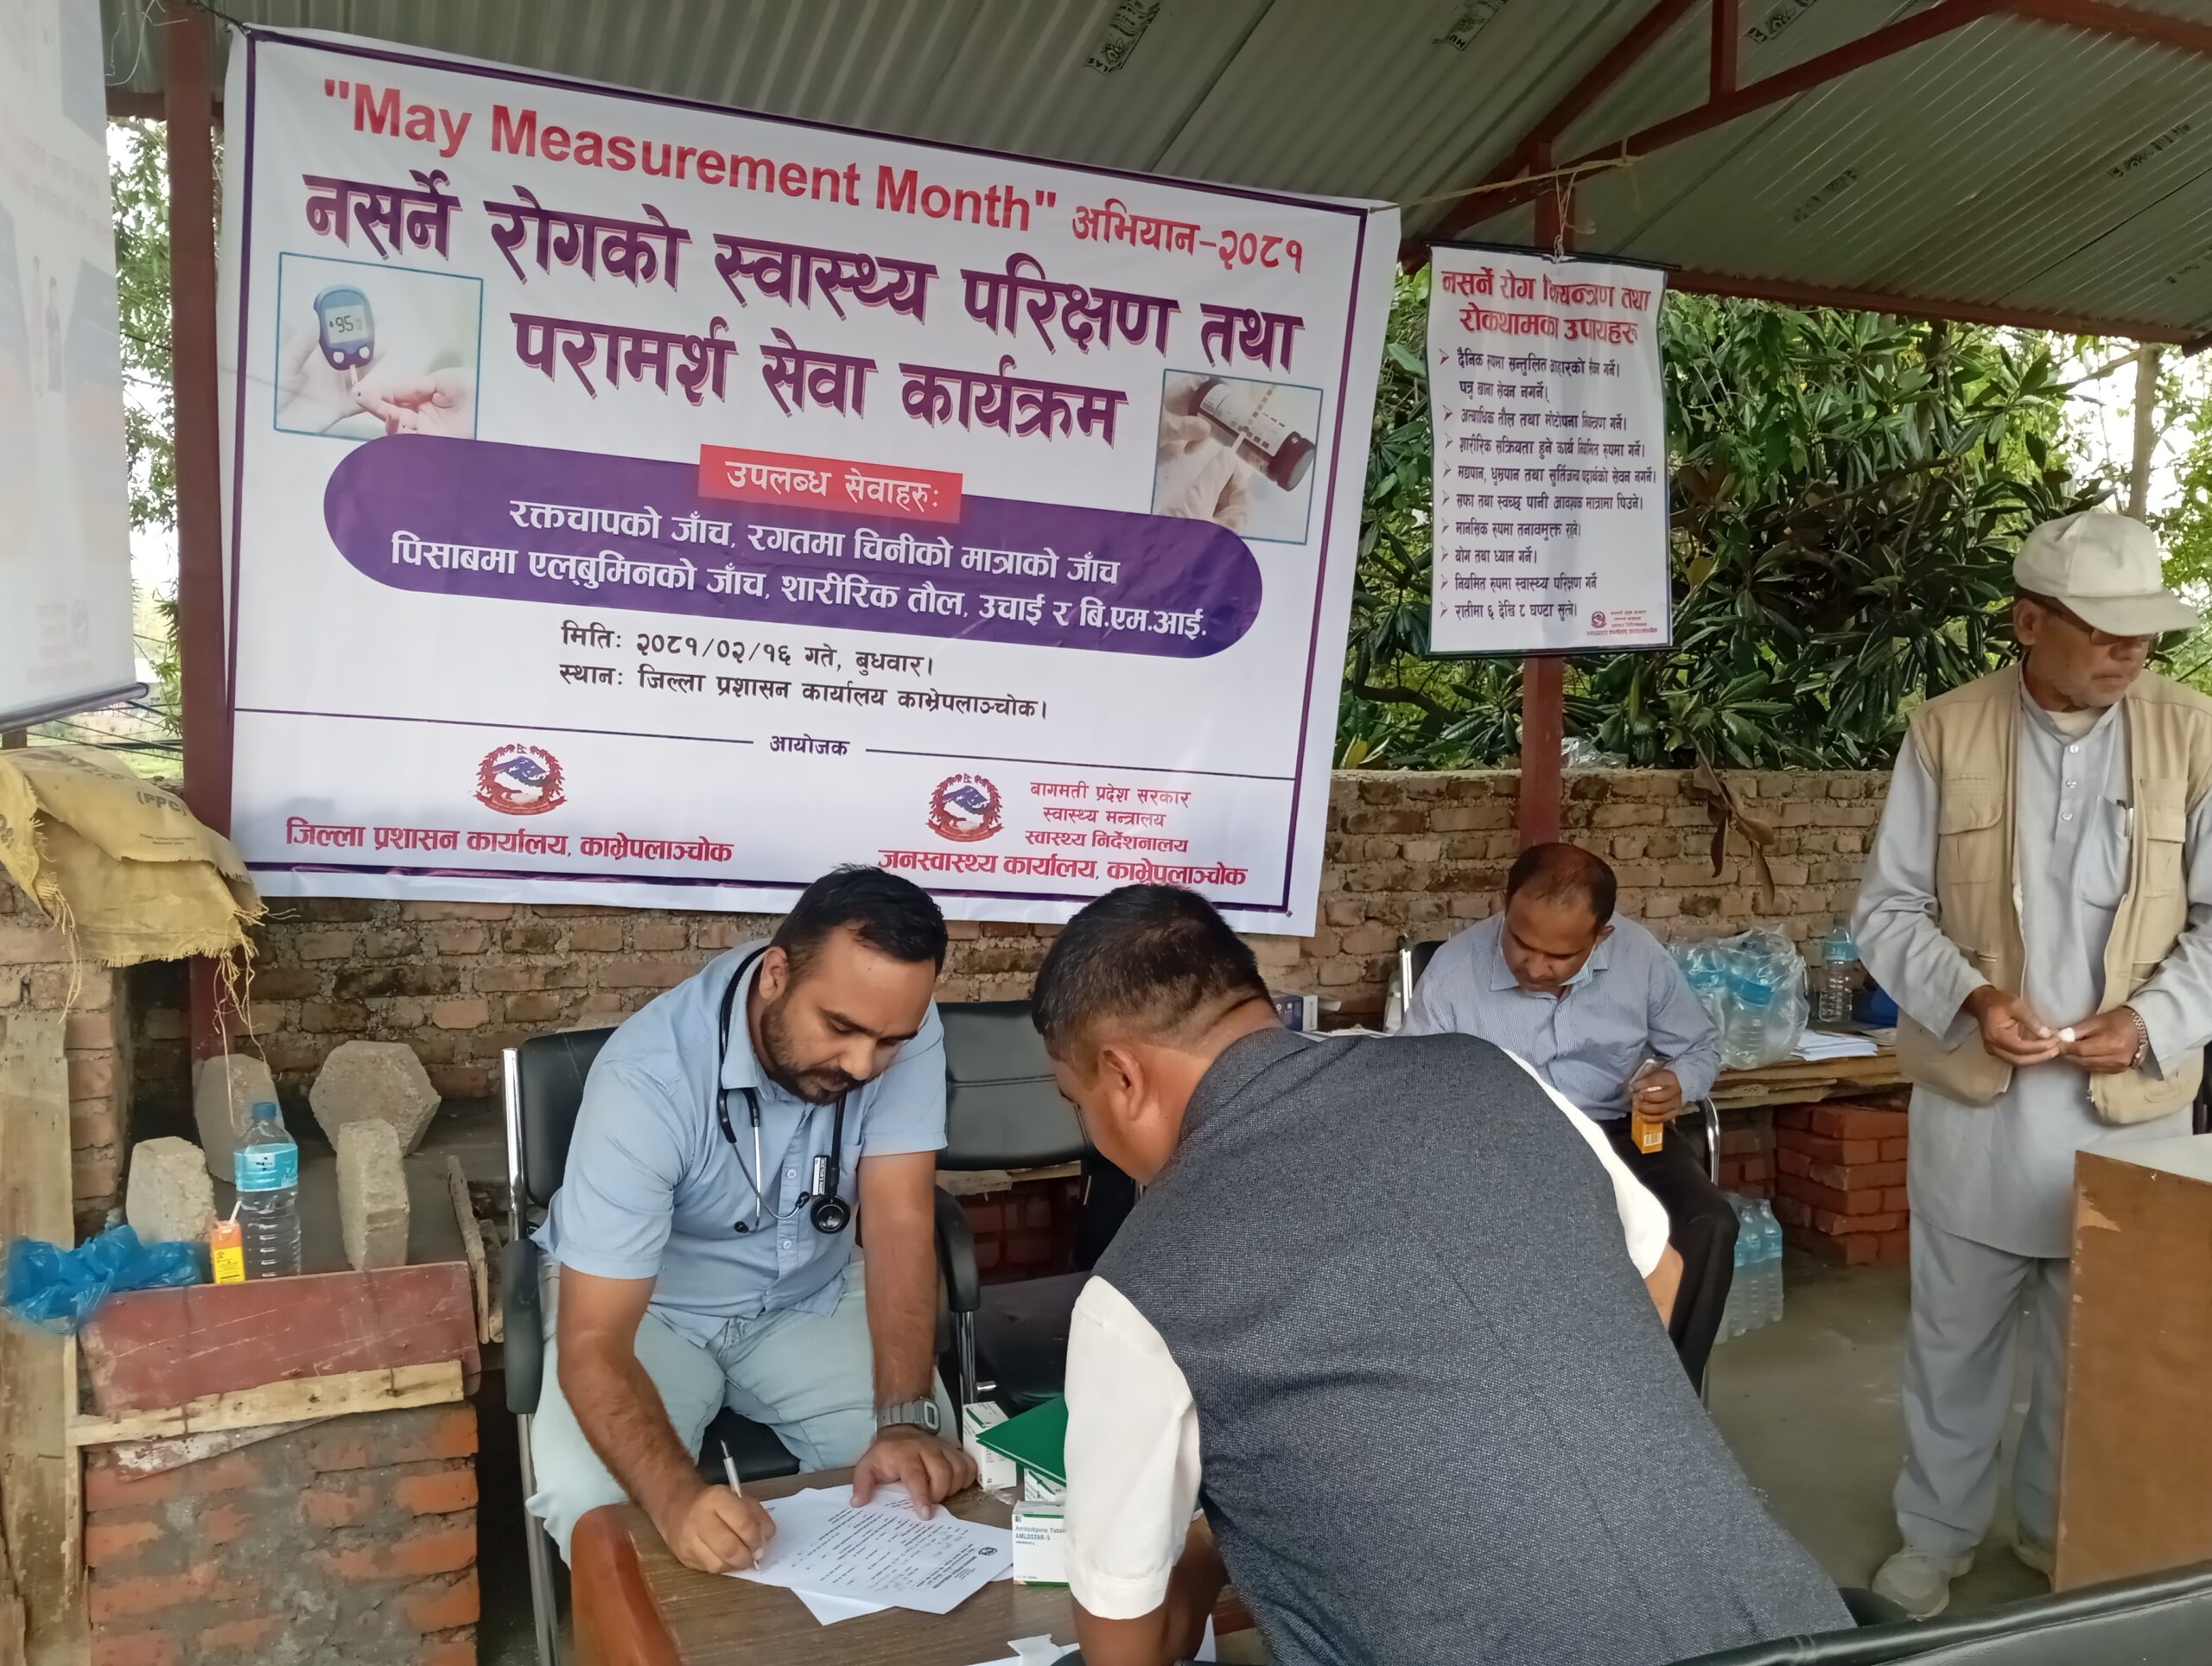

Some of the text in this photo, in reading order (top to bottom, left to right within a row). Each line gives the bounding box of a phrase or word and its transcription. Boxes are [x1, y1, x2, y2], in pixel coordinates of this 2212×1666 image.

[323, 78, 1304, 274] "May Measurement Month" अभियान-२०८१
[302, 169, 1306, 374] नसर्ने रोगको स्वास्थ्य परिक्षण तथा
[1441, 267, 1494, 296] नसर्ने
[1500, 270, 1536, 300] रोग
[1621, 287, 1651, 311] तथा
[335, 315, 353, 333] 95
[1457, 347, 1484, 369] दैनिक
[1509, 353, 1548, 376] सन्तुलित
[510, 313, 1128, 448] परामर्श सेवा कार्यक्रम
[1497, 380, 1516, 399] सेवन
[1497, 407, 1516, 427] तौल
[1519, 413, 1541, 427] तथा
[1545, 410, 1578, 429] मोटोपना
[1459, 434, 1492, 455] शारीरिक
[1496, 436, 1535, 455] सक्रियता
[1539, 437, 1553, 460] हुने
[1556, 437, 1574, 455] कार्य
[726, 461, 939, 512] उपलब्ध सेवाहरु:
[1524, 468, 1545, 482] तथा
[1612, 467, 1631, 484] सेवन
[1457, 493, 1474, 510] सफा
[1478, 495, 1493, 508] तथा
[1497, 495, 1522, 511] स्वच्छ
[1527, 492, 1549, 509] पानी
[1586, 497, 1613, 510] मात्रामा
[510, 499, 1121, 585] रक्तचापको जाँच, रगतमा चिनीको मात्राको जाँच
[1456, 518, 1488, 537] मानसिक
[1517, 523, 1562, 541] तनावमुक्त
[1455, 546, 1471, 563] योग
[1475, 550, 1491, 563] तथा
[1494, 550, 1515, 563] ध्यान
[391, 531, 1207, 641] पिसाबमा एल्बुमिनको जाँच, शारीरिक तौल, उचाई र बि.एम.आई.
[1455, 572, 1486, 591] नियमित
[1515, 578, 1549, 591] स्वास्थ्य
[1455, 600, 1484, 620] रातीमा
[1488, 604, 1494, 620] ६
[1498, 600, 1515, 620] देखि
[1519, 604, 1525, 617] ८
[1530, 603, 1554, 617] घण्टा
[561, 620, 934, 677] मिति: २०८१/०२/१६ गते, बुधवार।
[559, 664, 623, 686] स्थान:
[638, 663, 706, 693] जिल्ला
[716, 674, 792, 700] प्रशासन
[802, 681, 887, 708] कार्यालय
[769, 733, 850, 757] आयोजक
[137, 792, 188, 817] (PPC)
[1030, 780, 1192, 809] बागमती प्रदेश सरकार
[1043, 807, 1166, 828] स्वास्थ्य मन्त्रालय
[285, 816, 734, 862] जिल्ला प्रशासन कार्यालय, काभ्रेपलाञ्चोक
[1025, 830, 1189, 854] स्वास्थ्य निर्देशनालय
[878, 849, 1249, 887] जनस्वास्थ्य कार्यालय, काभ्रेपलाञ्चोक
